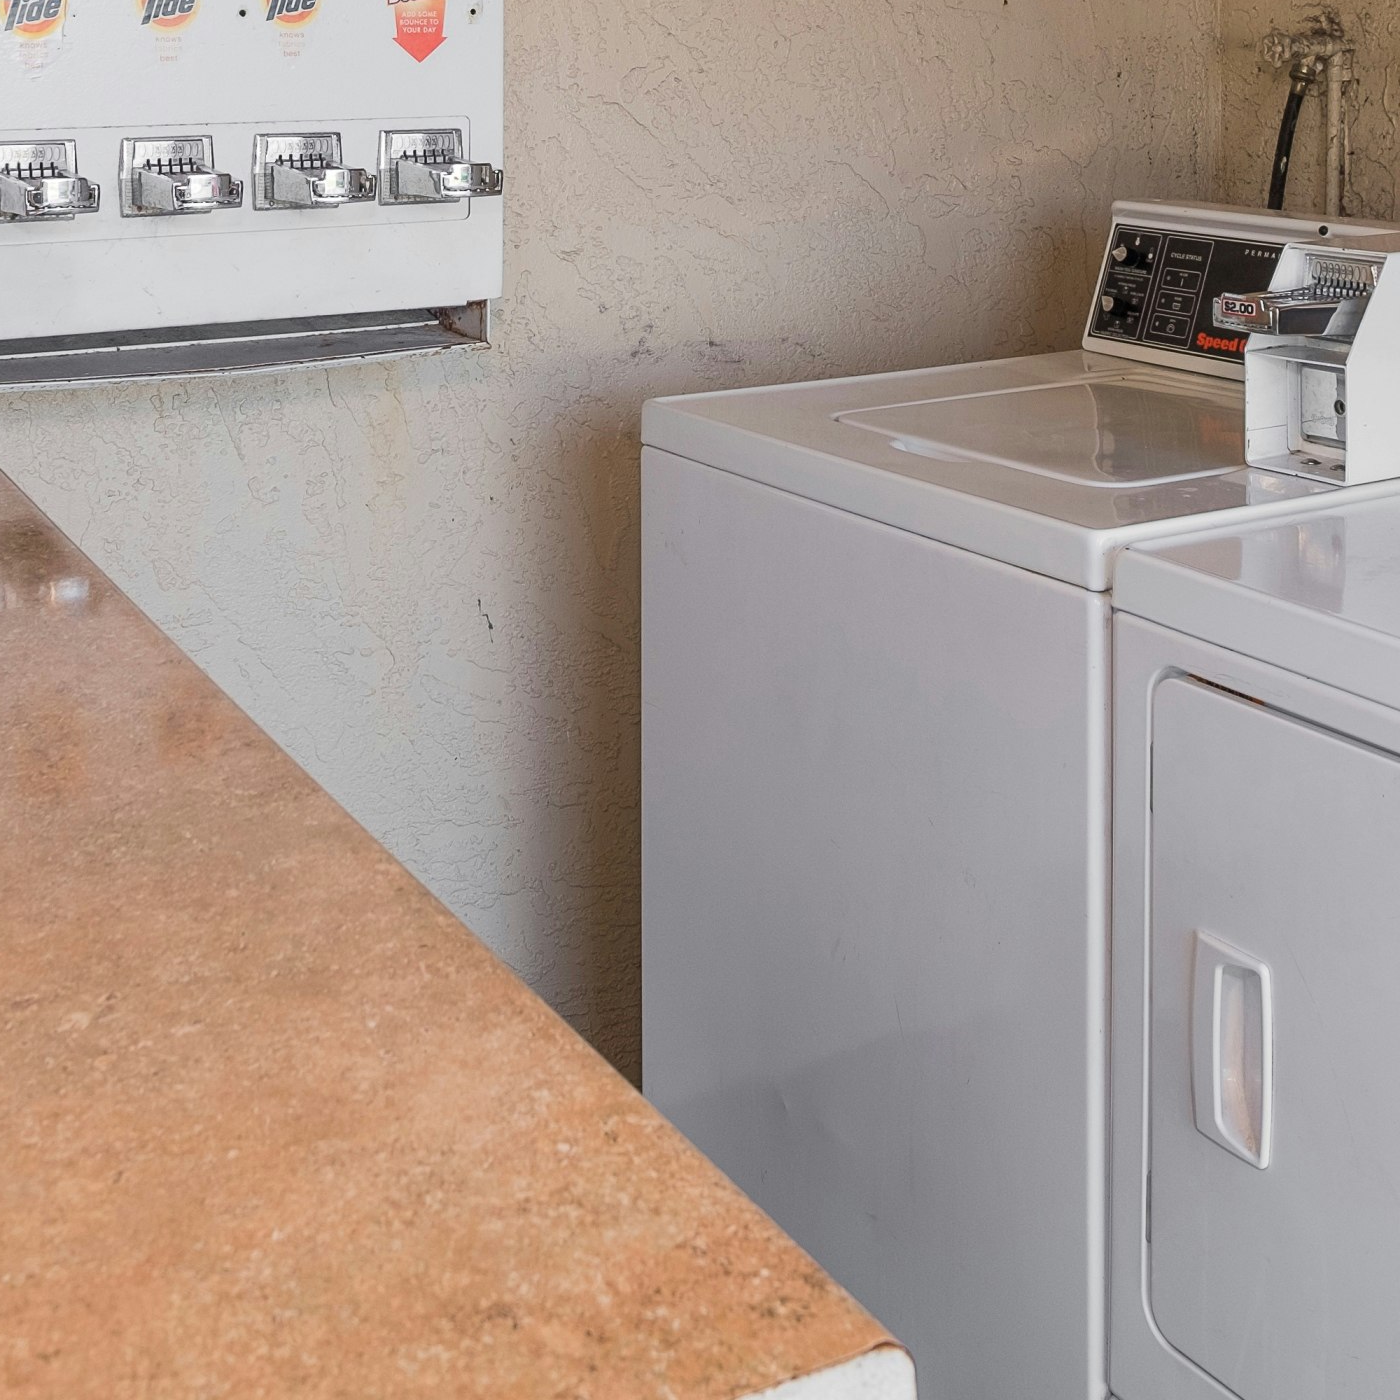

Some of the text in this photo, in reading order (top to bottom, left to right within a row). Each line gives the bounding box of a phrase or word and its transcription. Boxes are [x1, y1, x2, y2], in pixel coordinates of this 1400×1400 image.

[1244, 249, 1281, 259] PERMA
[1224, 300, 1254, 315] $2.00
[1196, 332, 1239, 352] Speed
